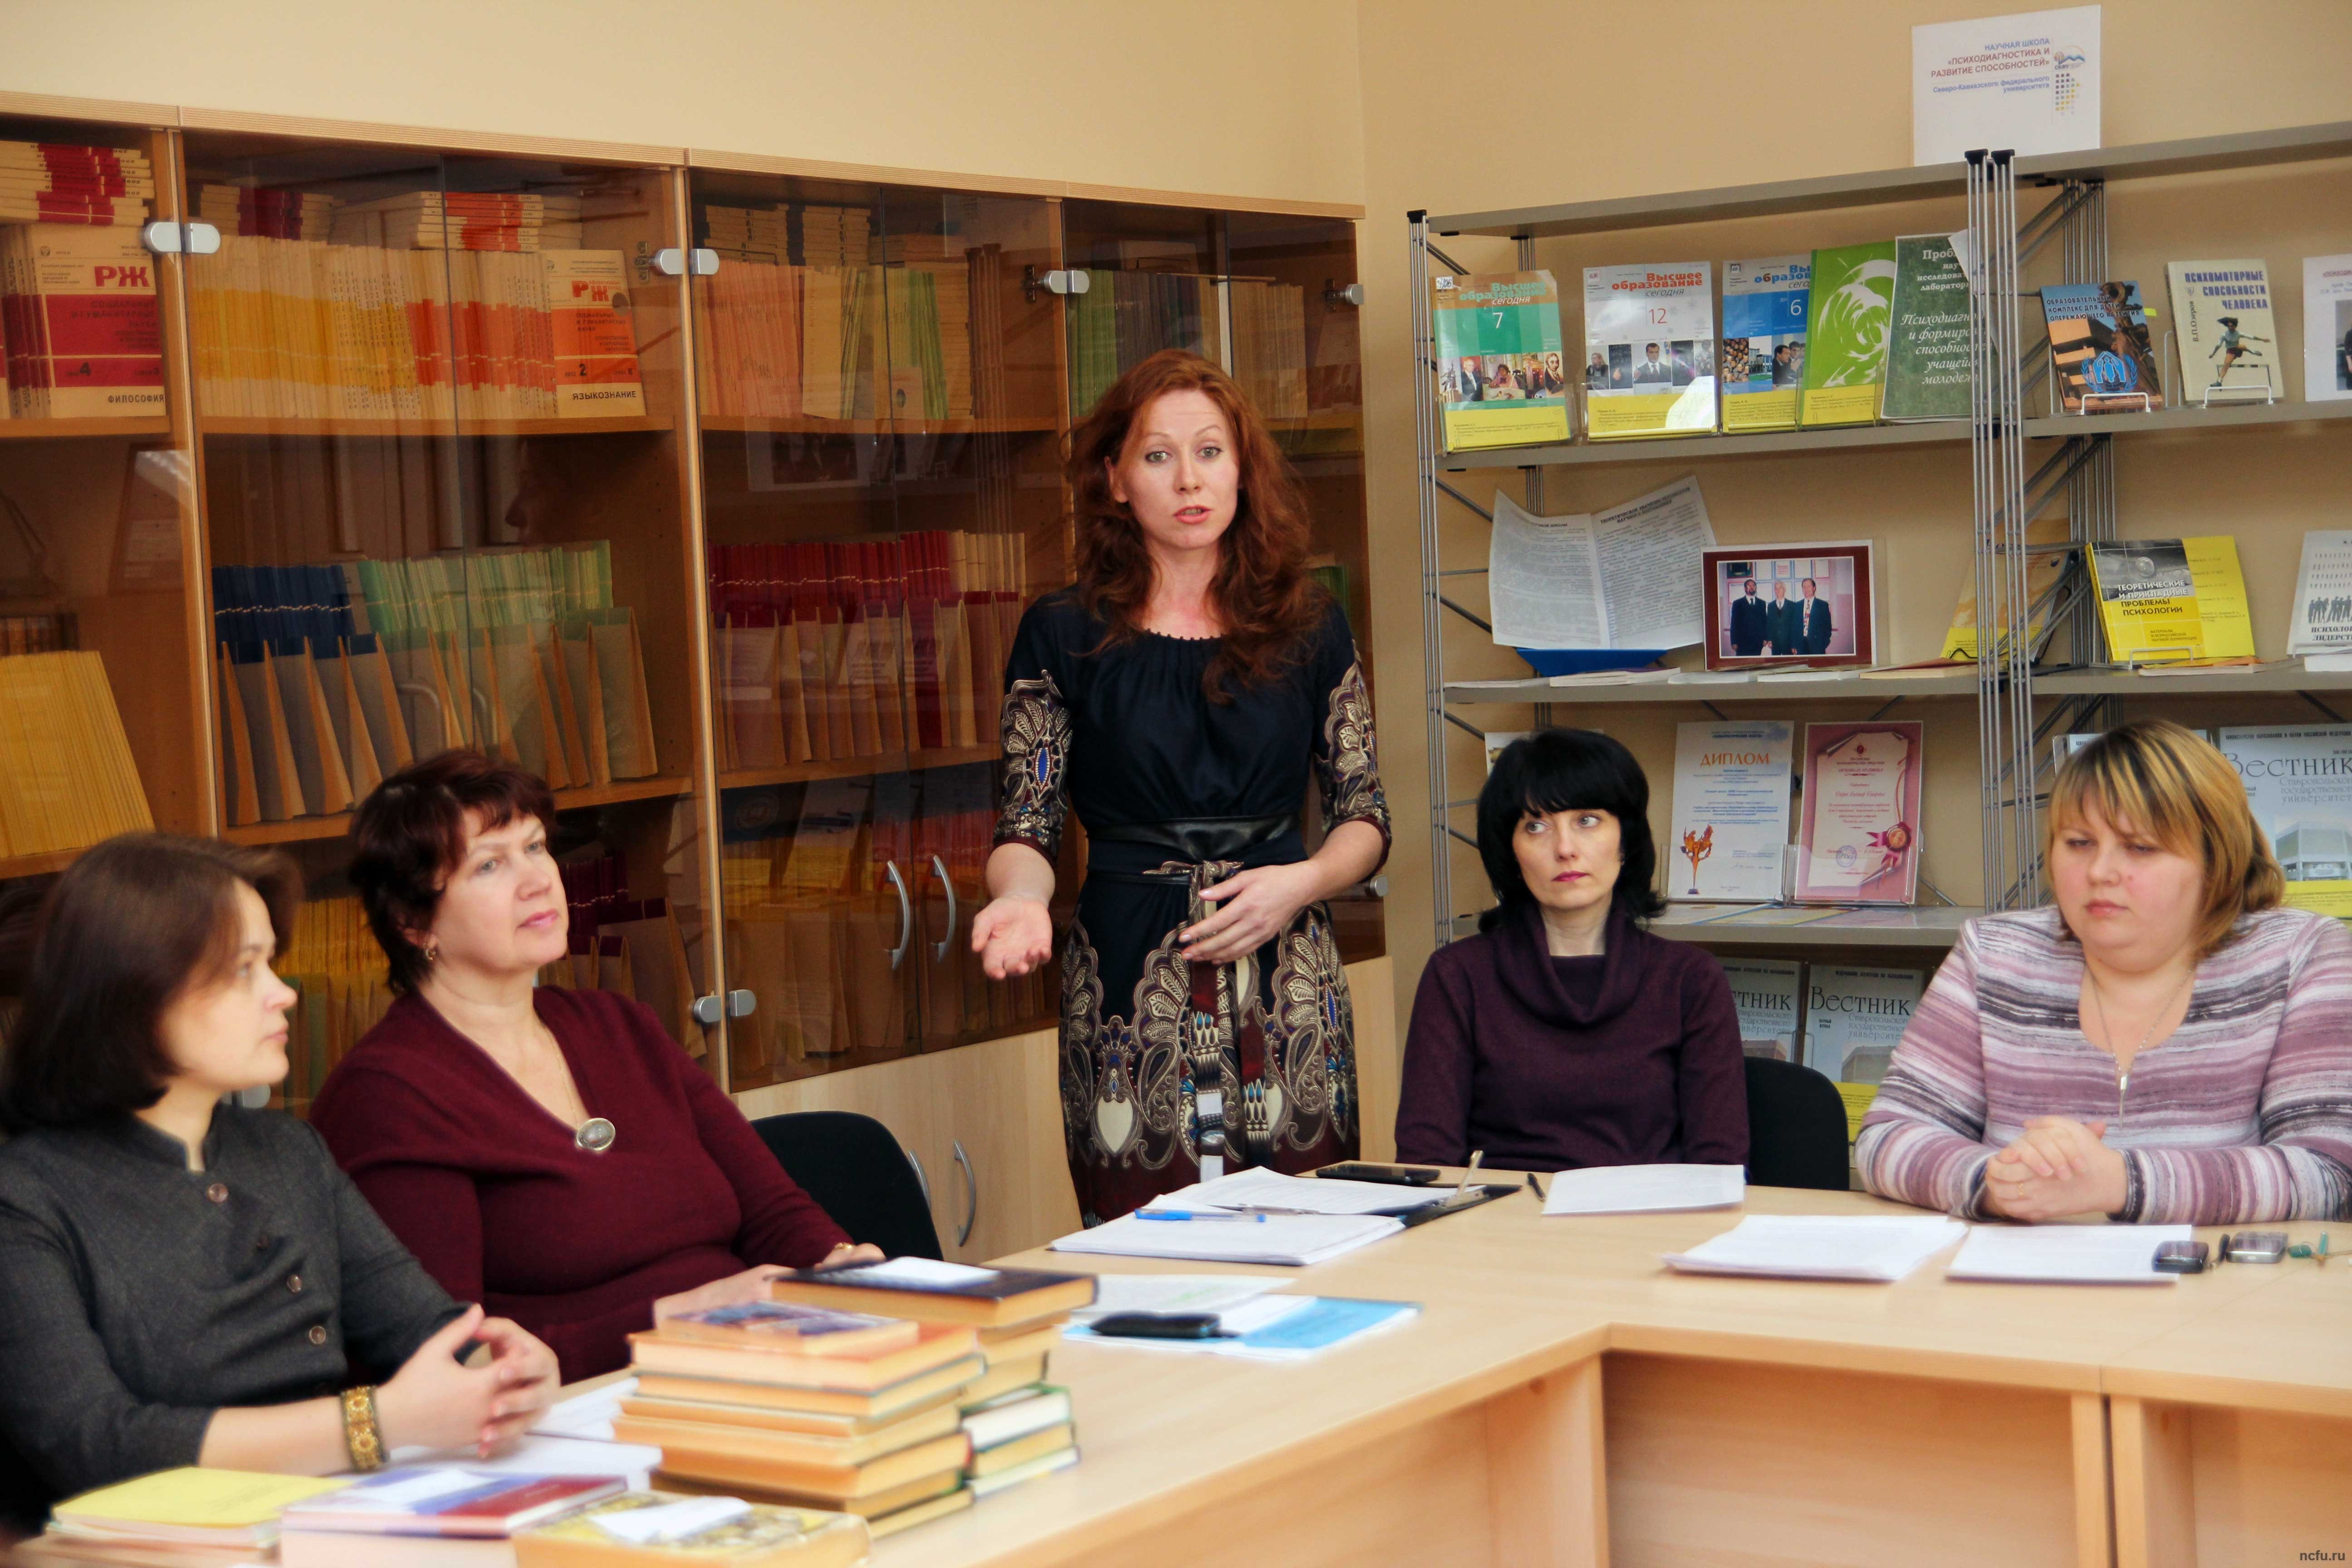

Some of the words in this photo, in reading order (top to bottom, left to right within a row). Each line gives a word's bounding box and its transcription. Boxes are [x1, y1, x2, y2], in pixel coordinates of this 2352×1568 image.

[1984, 41, 2020, 51] НАУЧНАЯ
[2022, 38, 2050, 47] ШКОЛА
[1948, 48, 2042, 65] «ПСИХОДИАГНОСТИКА
[1931, 67, 1973, 78] РАЗВИТИЕ
[1975, 58, 2050, 73] СПОСОБНОСТЕЙ»
[1933, 81, 1999, 93] Северо-Кавказского
[2000, 76, 2050, 86] федерального
[2003, 82, 2050, 93] университета
[94, 265, 150, 287] РЖ
[1646, 272, 1702, 282] Высшее
[2185, 270, 2264, 283] ПСИХОМОТОРНЫЕ
[1491, 282, 1547, 292] Высшее
[1612, 279, 1703, 291] образование
[2202, 284, 2266, 297] СПОСОБНОСТИ
[1459, 289, 1547, 303] образование
[1646, 289, 1685, 297] сегодня
[1492, 295, 1531, 305] сегодня
[2047, 295, 2111, 305] ОБРАЗОВАТЕЛЬНЫЙ
[2221, 298, 2269, 310] ЧЕЛОВЕКА
[1790, 299, 1802, 316] 6
[2100, 303, 2121, 311] ДЕТЕЙ
[1492, 312, 1503, 329] 7
[1648, 308, 1667, 324] 12
[1901, 311, 1977, 326] Психодиагн
[2050, 312, 2104, 321] ОПЕРЕЖАЮЩЕГО
[2106, 309, 2140, 318] РАЗВИТИЯ
[1908, 332, 1916, 340] и
[79, 362, 92, 376] 4
[578, 363, 587, 376] 2
[108, 394, 164, 403] ФИЛОСОФИЯ
[573, 390, 637, 400] ЯЗЫКОЗНАНИЕ
[2117, 580, 2185, 591] ТЕОРЕТИЧЕСКИЕ
[2127, 589, 2188, 599] ПРИКЛАДНЫЕ
[2121, 598, 2170, 607] ПРОБЛЕМЫ
[2123, 606, 2183, 616] ПСИХОЛОГИИ
[1700, 752, 1769, 767] ДИПЛОМ
[1809, 986, 1911, 1016] Вестник
